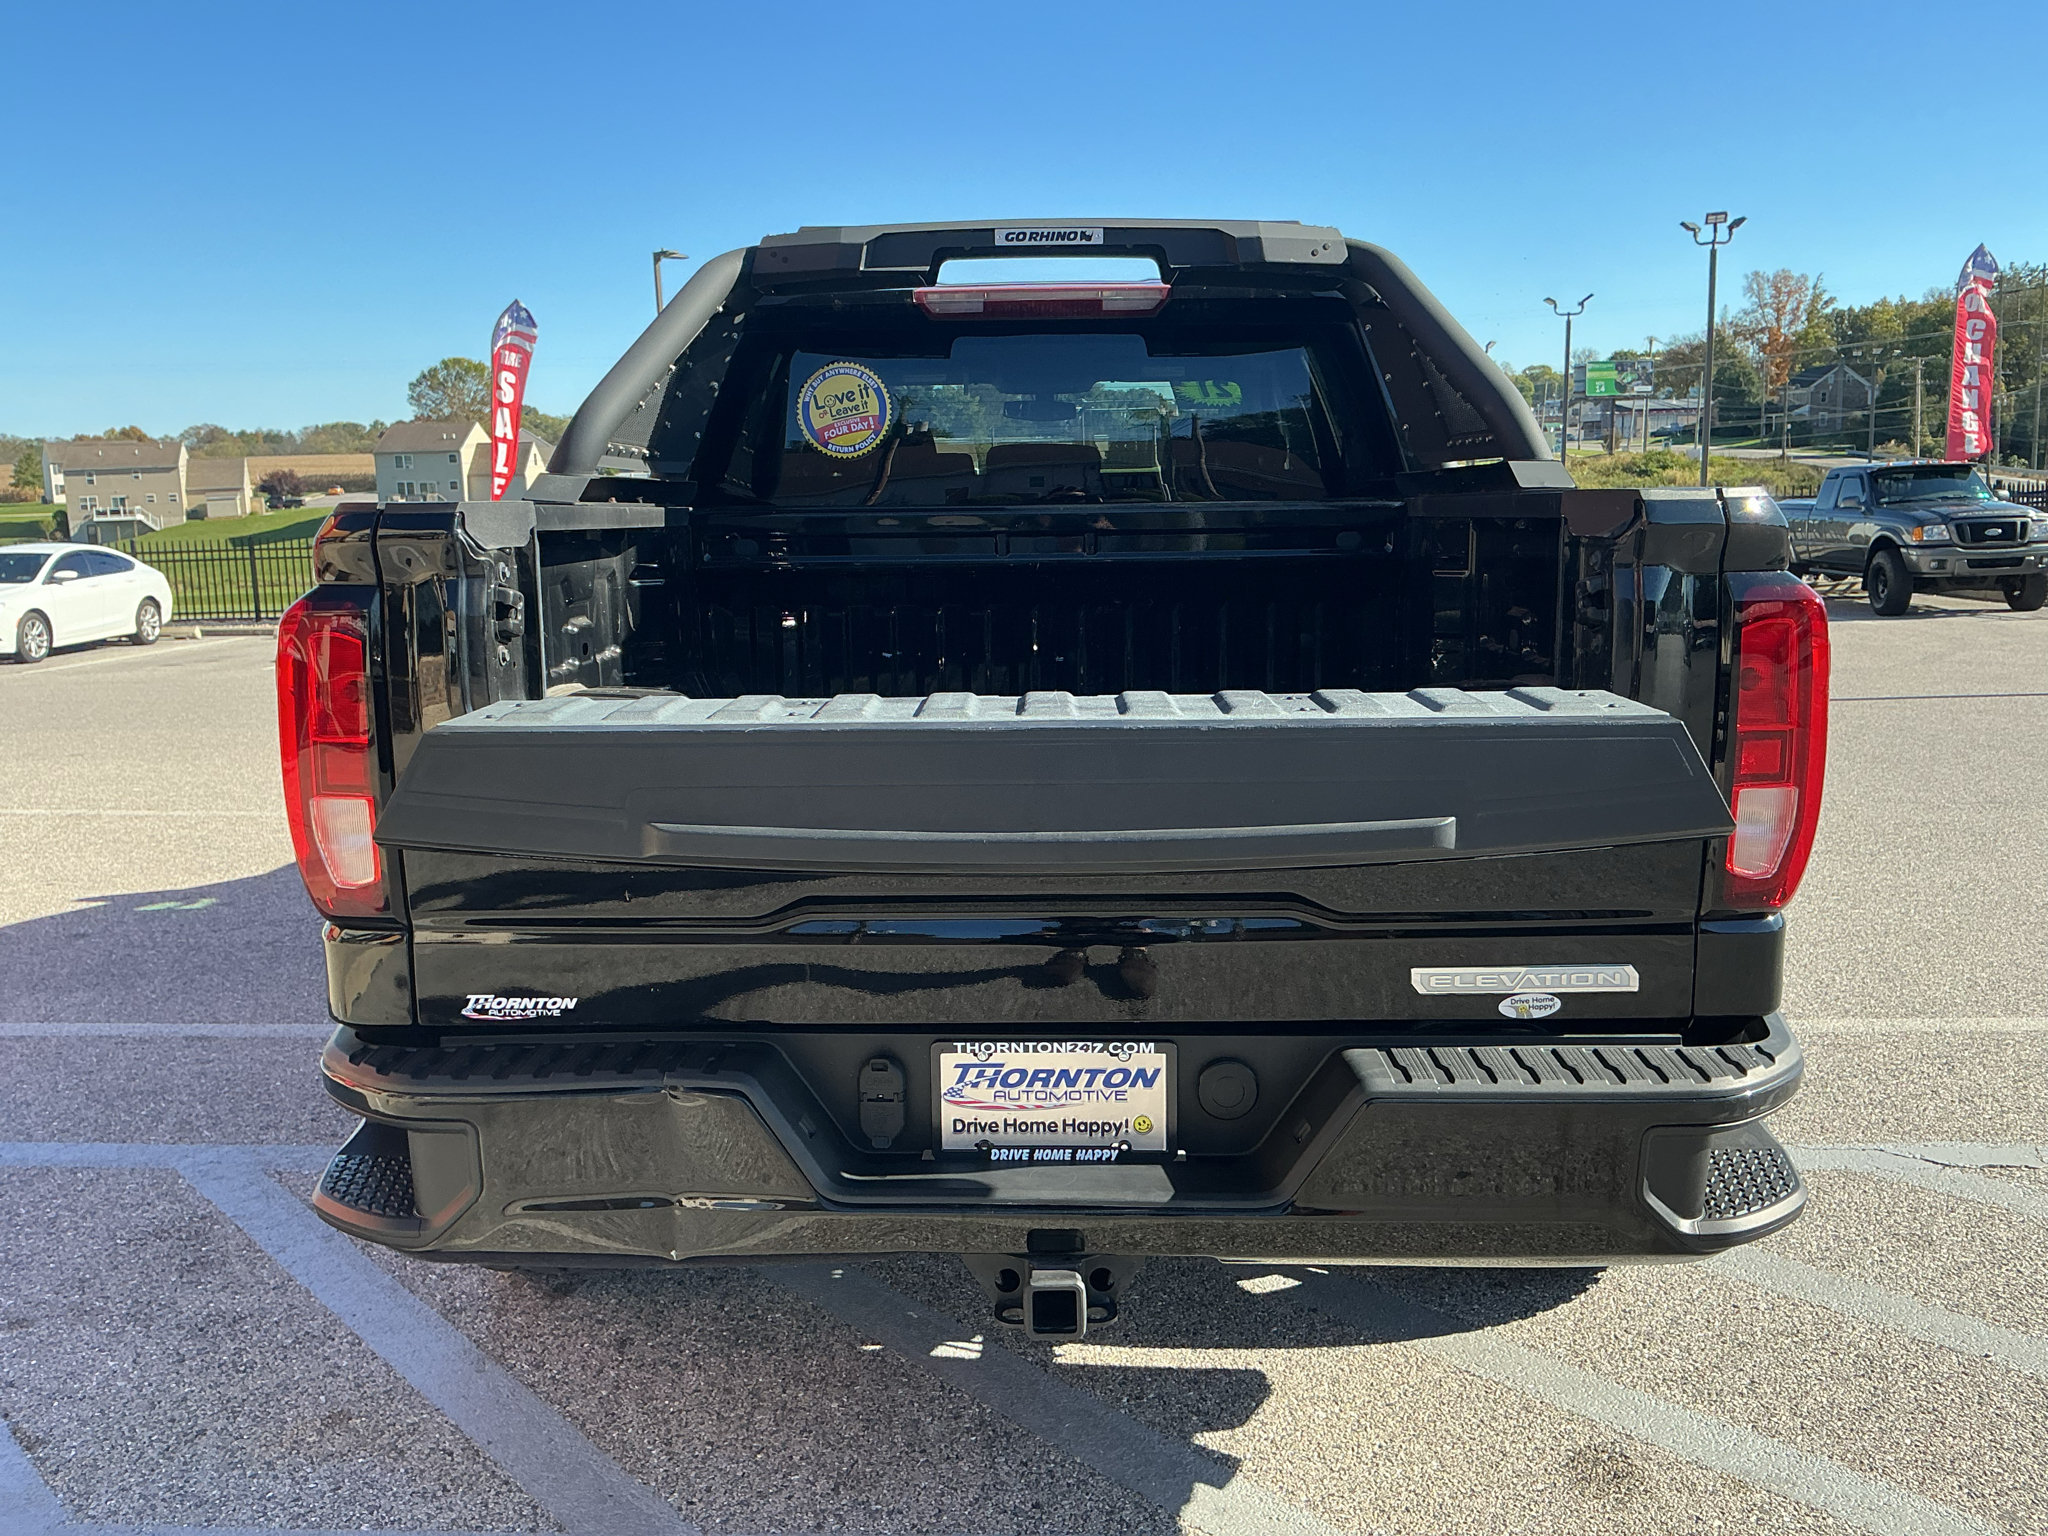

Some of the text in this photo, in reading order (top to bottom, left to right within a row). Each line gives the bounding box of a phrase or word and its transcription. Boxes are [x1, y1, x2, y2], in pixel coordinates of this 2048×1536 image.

[500, 350, 521, 368] TIRE
[804, 368, 878, 402] WHY BUY ANYWHERE ELSE?
[1961, 318, 1986, 454] CHANGE
[813, 383, 870, 411] Love it
[819, 400, 869, 419] OR Leave it
[834, 417, 860, 428] EXCLUSIVE
[494, 370, 516, 495] SALE
[824, 425, 849, 440] FOUR
[827, 434, 876, 453] RETURN POLICY
[1429, 972, 1621, 987] ELEVATION
[464, 994, 578, 1009] THORNTON
[1510, 996, 1555, 1005] Drive Home
[1528, 1002, 1556, 1011] Happy!
[952, 1042, 1155, 1054] THORNTON247.COM
[953, 1062, 1162, 1088] THORNTON
[993, 1090, 1128, 1101] AUTOMOTIVE
[952, 1118, 1129, 1137] Drive Home Happy!
[990, 1150, 1119, 1161] DRIVE HOME HAPPY
